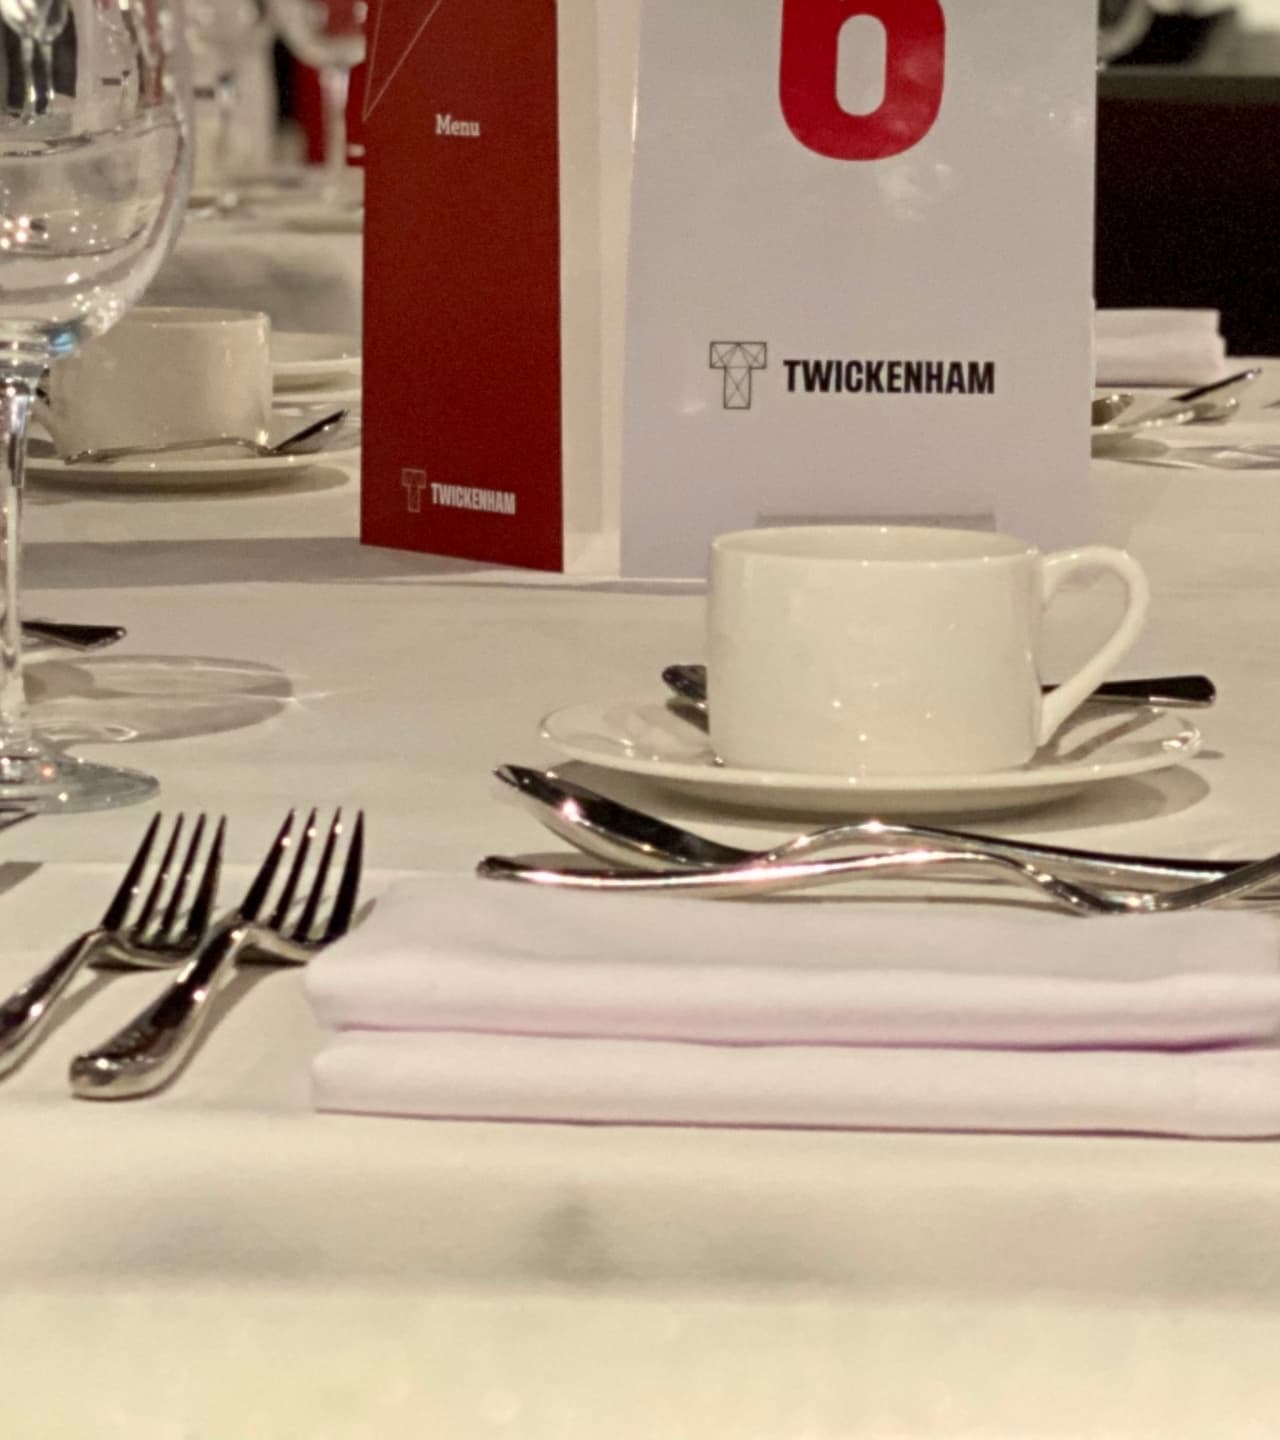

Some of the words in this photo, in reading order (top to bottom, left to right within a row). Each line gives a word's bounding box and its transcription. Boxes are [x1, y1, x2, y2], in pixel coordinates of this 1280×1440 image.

[434, 112, 481, 137] Menu
[783, 359, 995, 395] TWICKENHAM
[430, 482, 516, 516] TWICKENHAM
